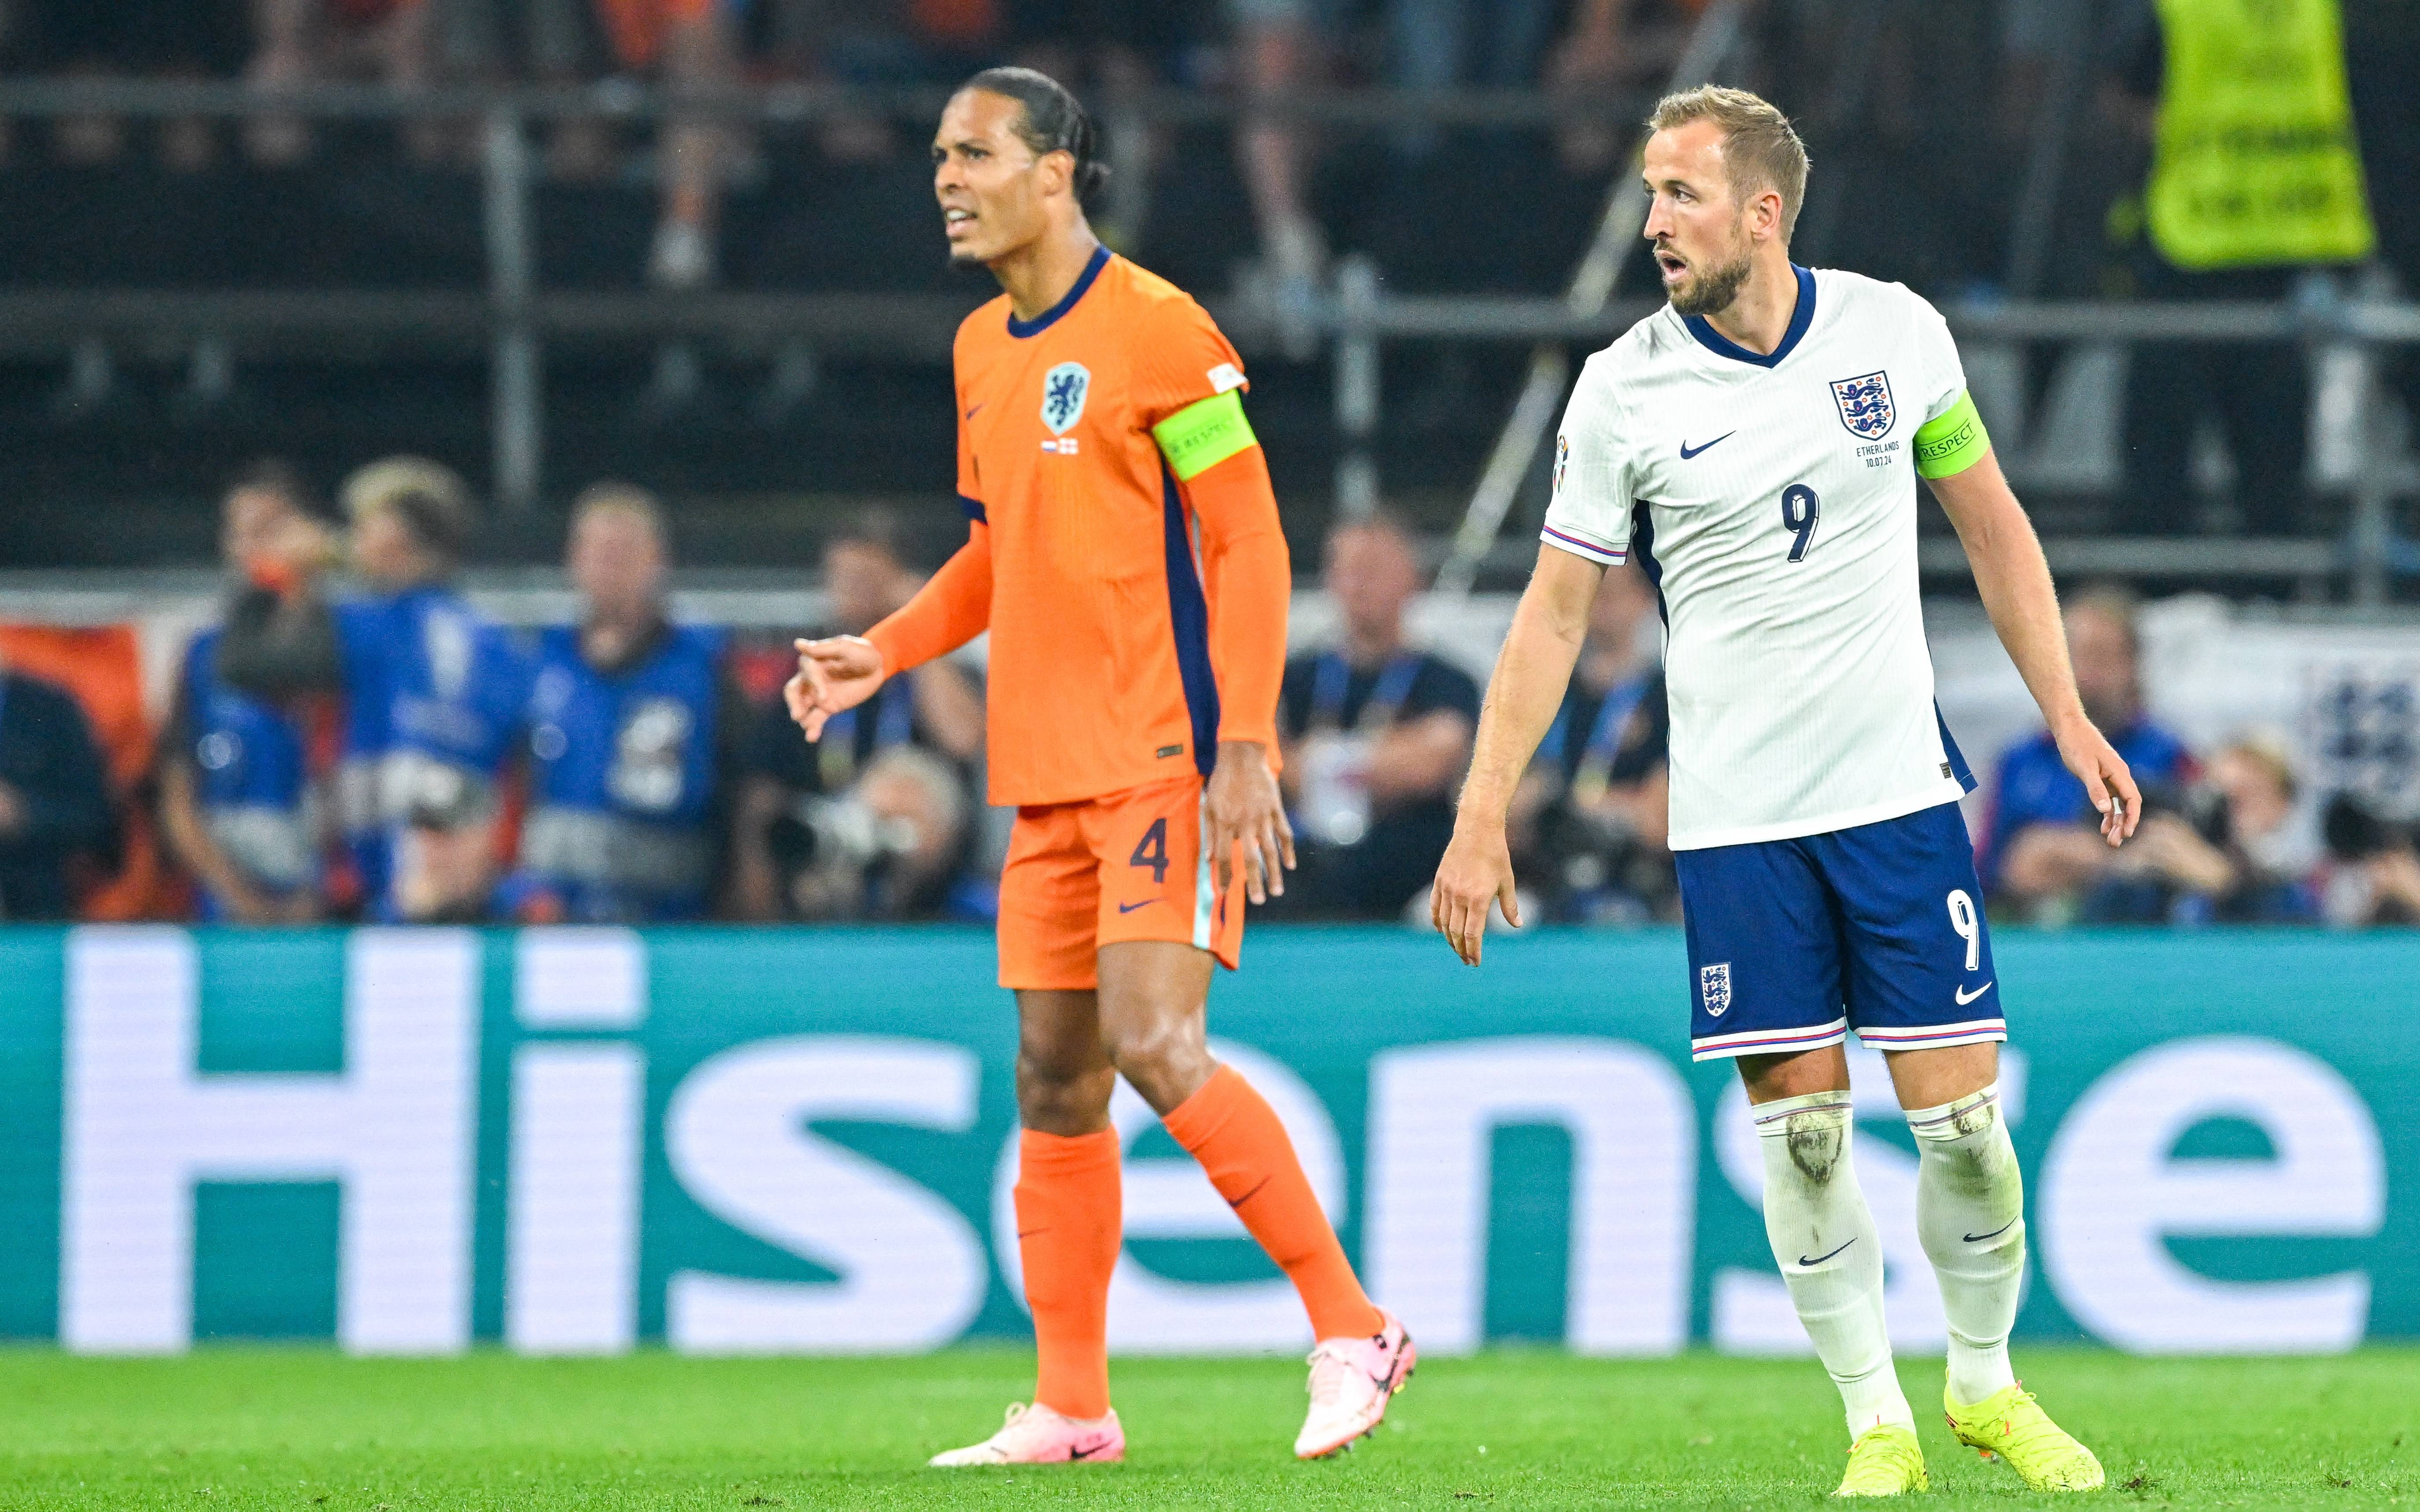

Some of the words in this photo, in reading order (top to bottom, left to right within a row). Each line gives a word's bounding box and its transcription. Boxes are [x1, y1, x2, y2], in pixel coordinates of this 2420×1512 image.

[1856, 441, 1899, 457] ETHERLANDS
[1866, 455, 1892, 468] 10.07.24
[1921, 422, 1973, 457] RESPECT
[1782, 484, 1820, 562] 9
[1130, 817, 1169, 883] 4
[1947, 889, 1979, 971] 9
